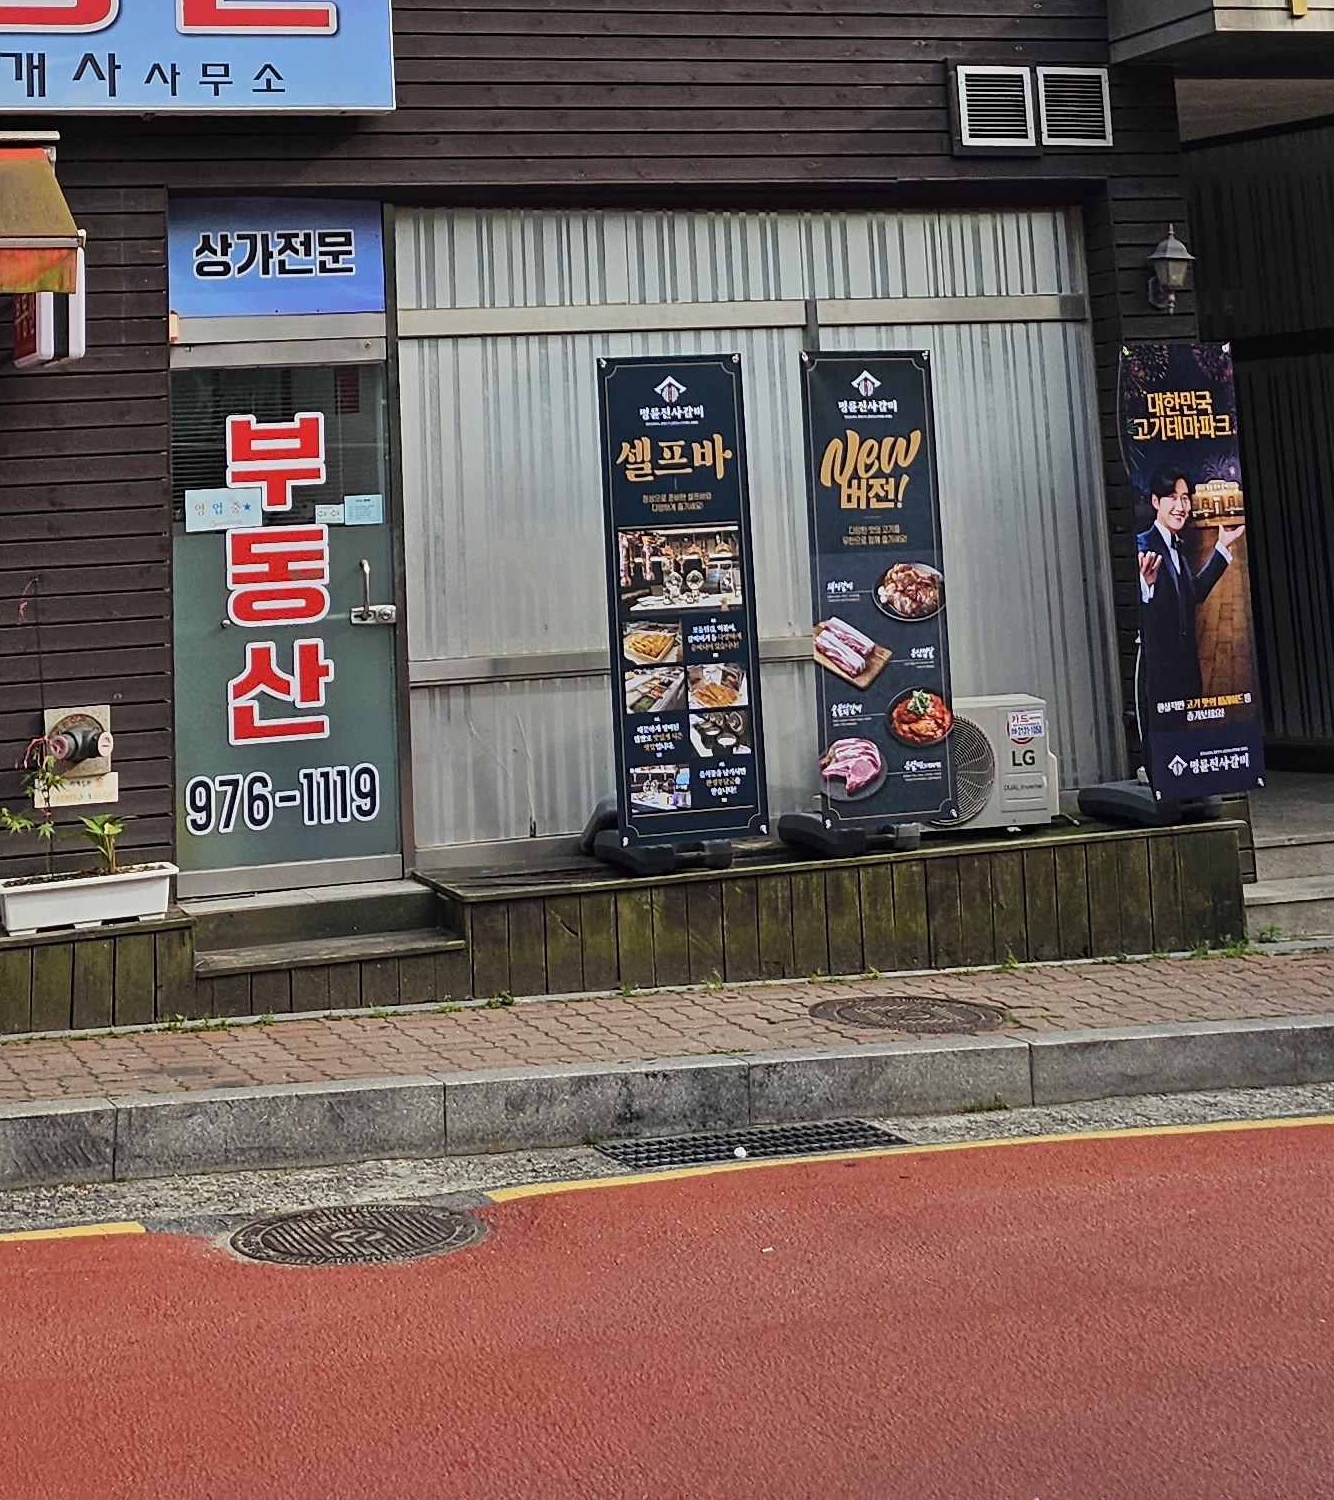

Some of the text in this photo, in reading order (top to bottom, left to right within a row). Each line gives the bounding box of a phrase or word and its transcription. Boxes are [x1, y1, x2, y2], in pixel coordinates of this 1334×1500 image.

[192, 228, 357, 279] 상가전문
[1132, 414, 1233, 441] 고기테마파크
[1146, 390, 1213, 417] 대한민국
[616, 433, 733, 483] 셀프바
[819, 429, 922, 487] New
[840, 473, 910, 510] 버전!
[224, 410, 335, 748] 부동산
[1011, 749, 1036, 767] LG
[185, 761, 381, 838] 976-1119
